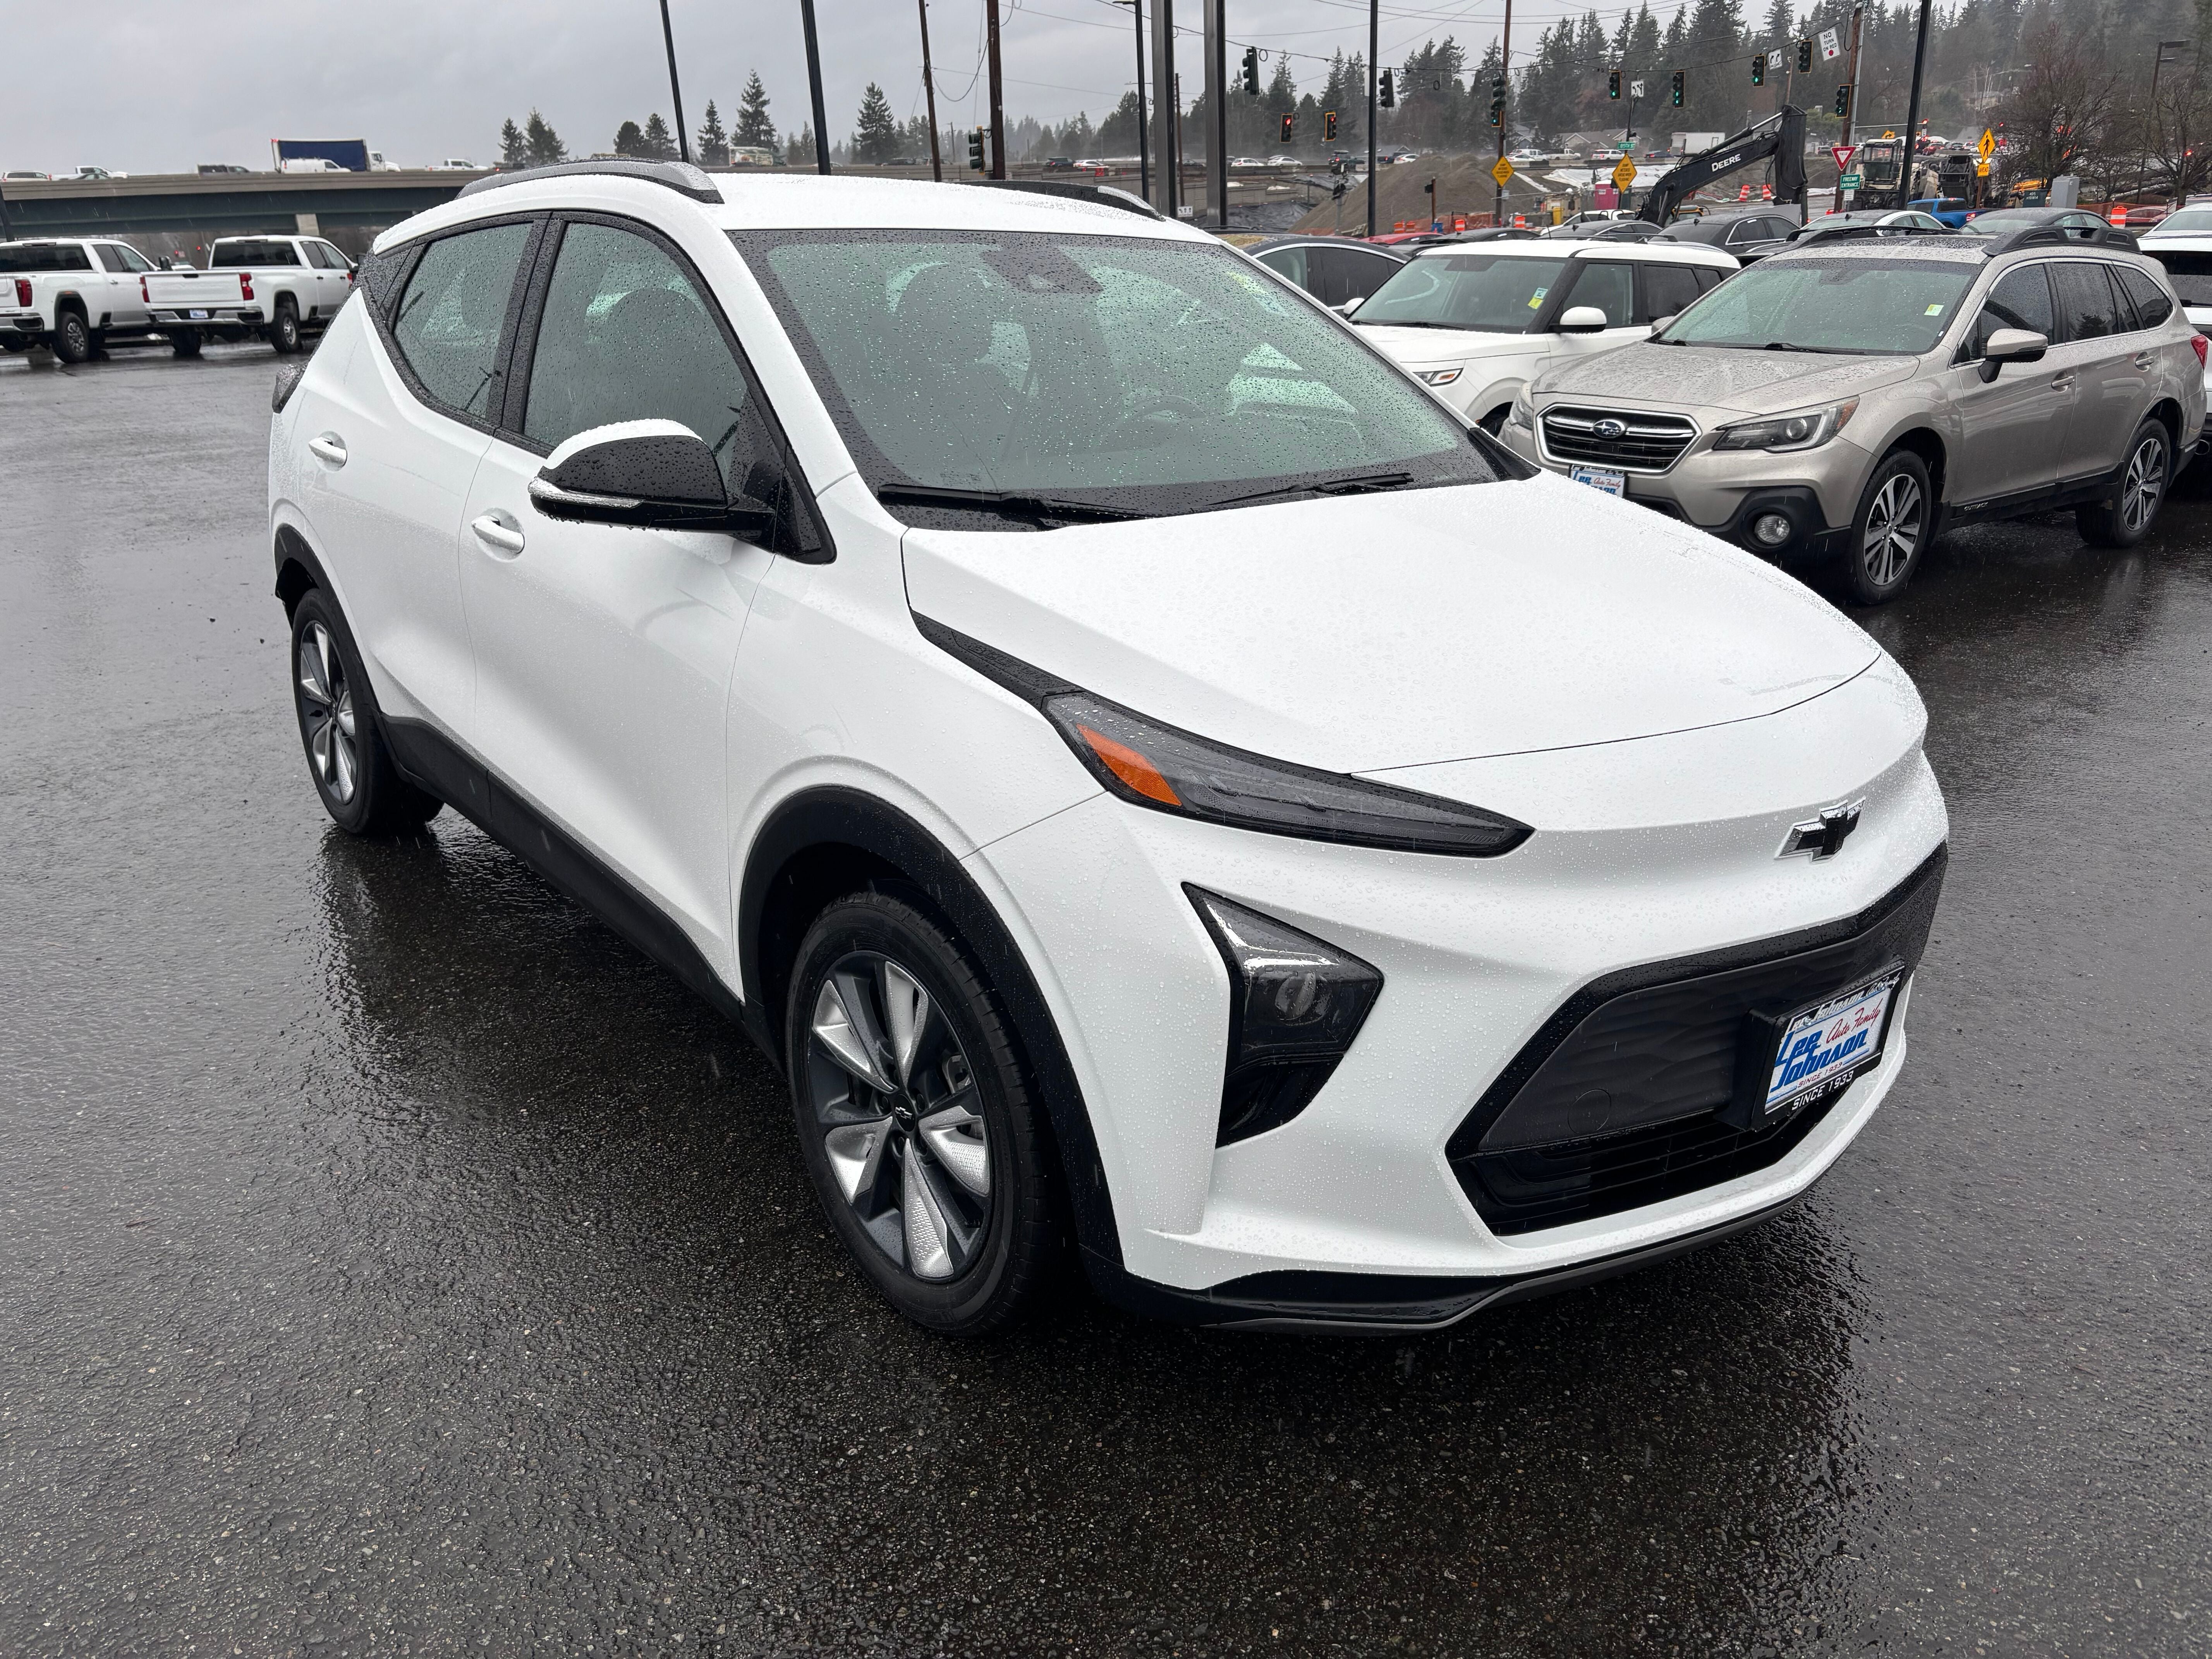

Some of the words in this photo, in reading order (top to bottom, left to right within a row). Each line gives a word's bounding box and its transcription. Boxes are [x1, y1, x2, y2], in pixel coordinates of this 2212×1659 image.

[1712, 153, 1741, 172] DEERE
[1606, 479, 1621, 489] Family
[1826, 1018, 1850, 1044] Auto
[1851, 998, 1883, 1032] Family
[1770, 1028, 1869, 1093] Johnson
[1774, 1030, 1823, 1068] Lee
[1792, 1085, 1823, 1111] SINCE
[1829, 1070, 1854, 1092] 1933
[1797, 1072, 1822, 1088] SINCE
[1824, 1062, 1843, 1075] 1933
